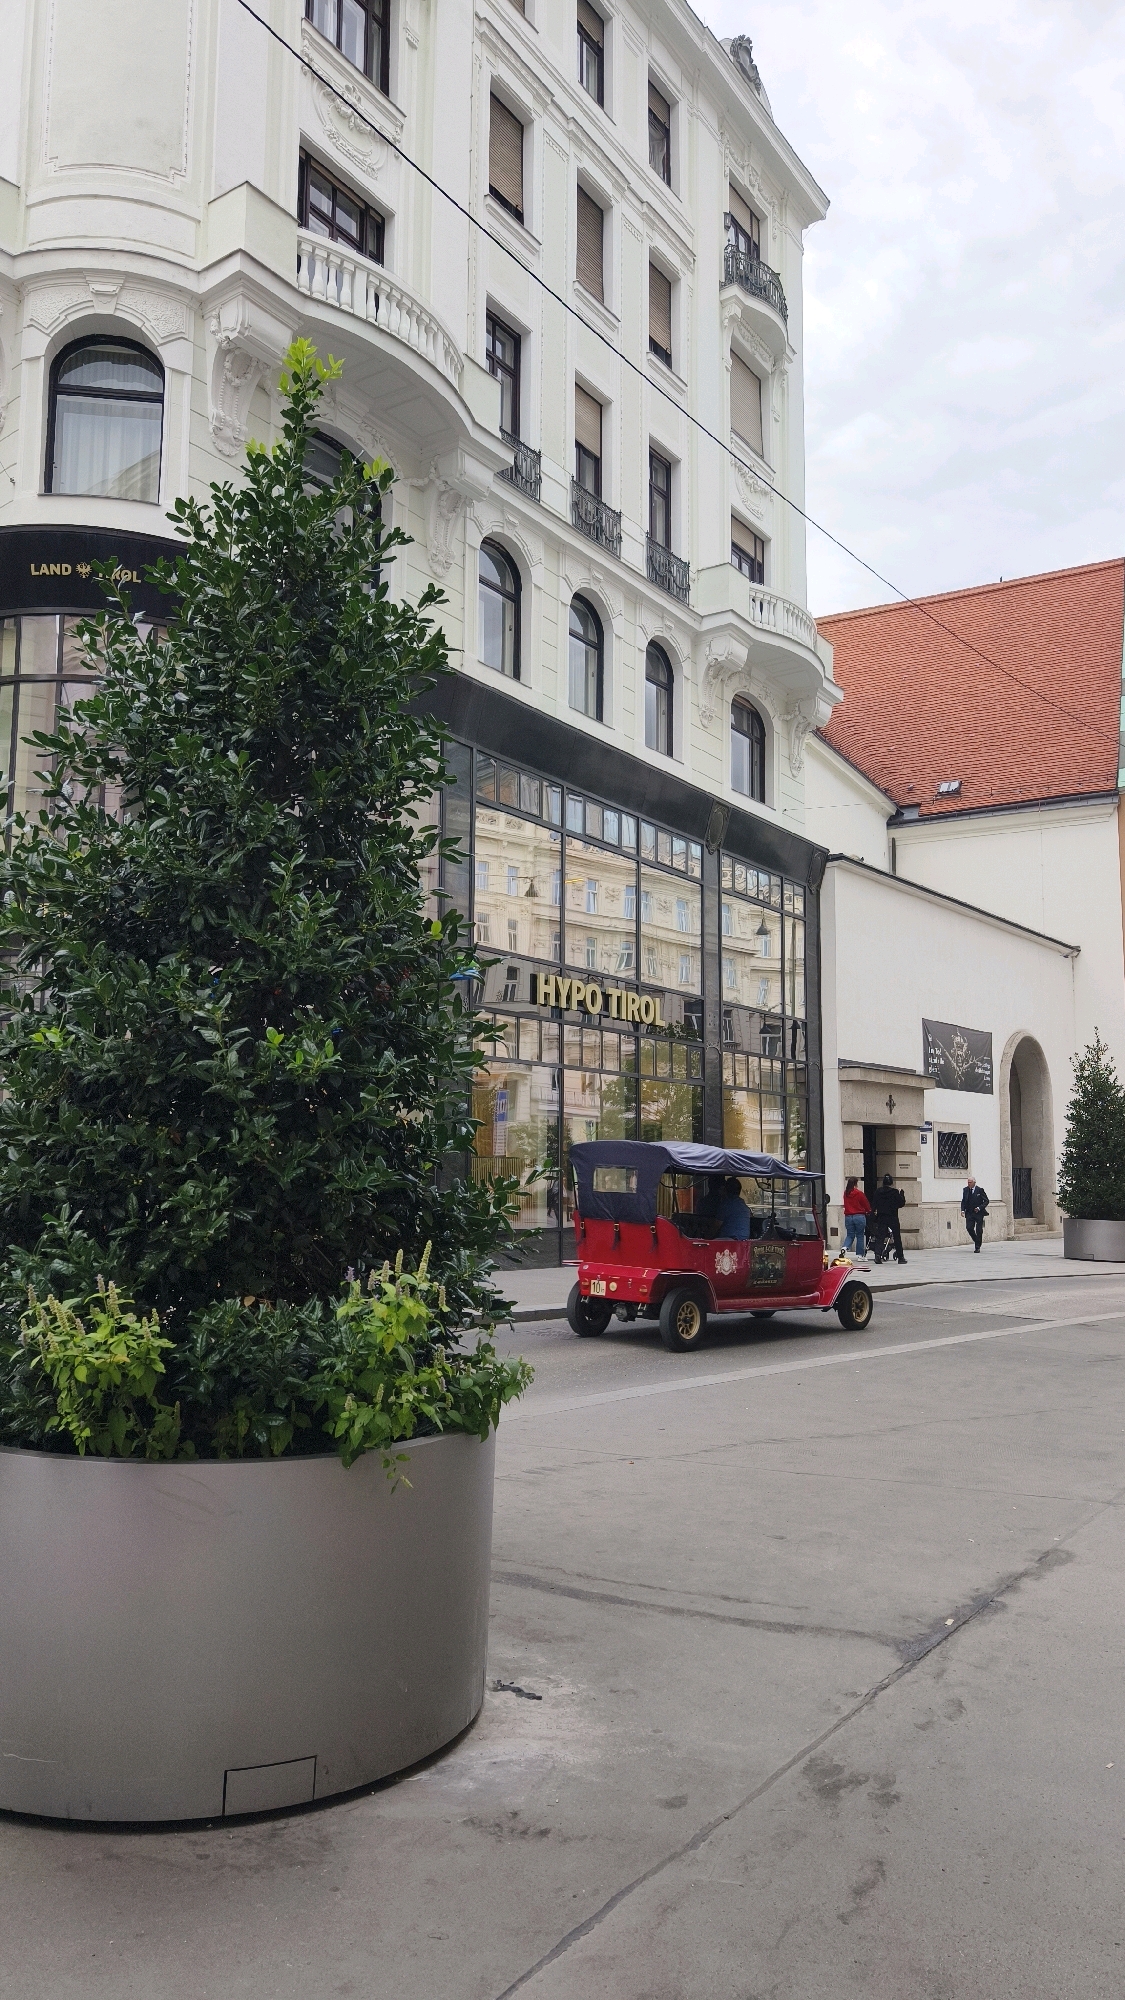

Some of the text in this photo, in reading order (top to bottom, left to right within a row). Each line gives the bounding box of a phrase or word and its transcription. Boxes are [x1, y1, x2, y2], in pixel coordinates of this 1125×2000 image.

[30, 563, 142, 583] LAND ROL
[536, 972, 666, 1027] HYPO TIROL
